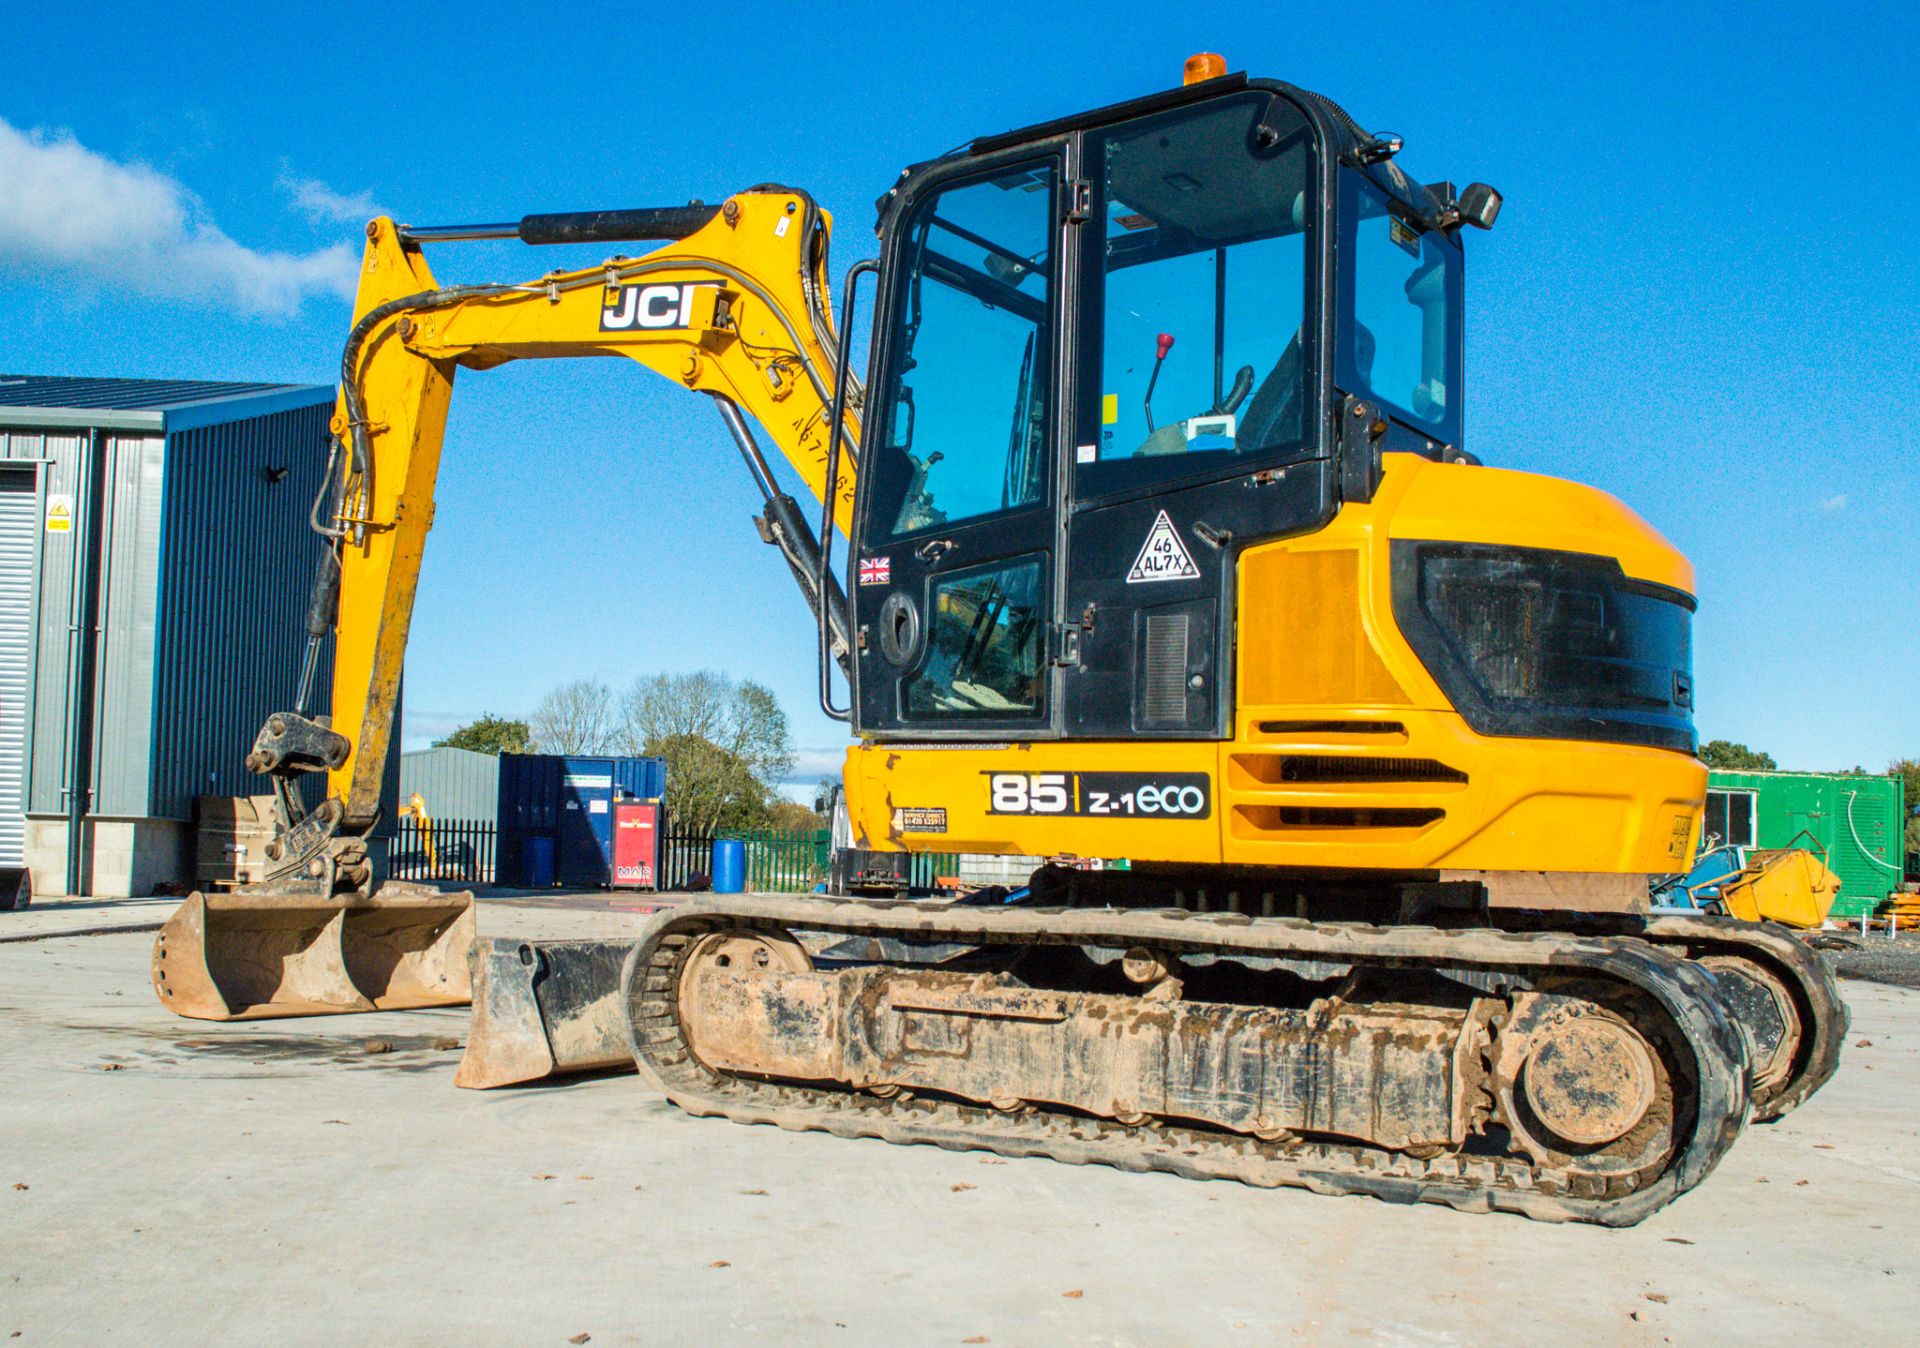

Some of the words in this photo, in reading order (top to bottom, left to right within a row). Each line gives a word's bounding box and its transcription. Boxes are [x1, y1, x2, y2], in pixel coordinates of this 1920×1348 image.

[603, 284, 720, 328] JC
[1153, 537, 1172, 553] 46
[1144, 554, 1182, 572] AL7X
[992, 774, 1067, 812] 85
